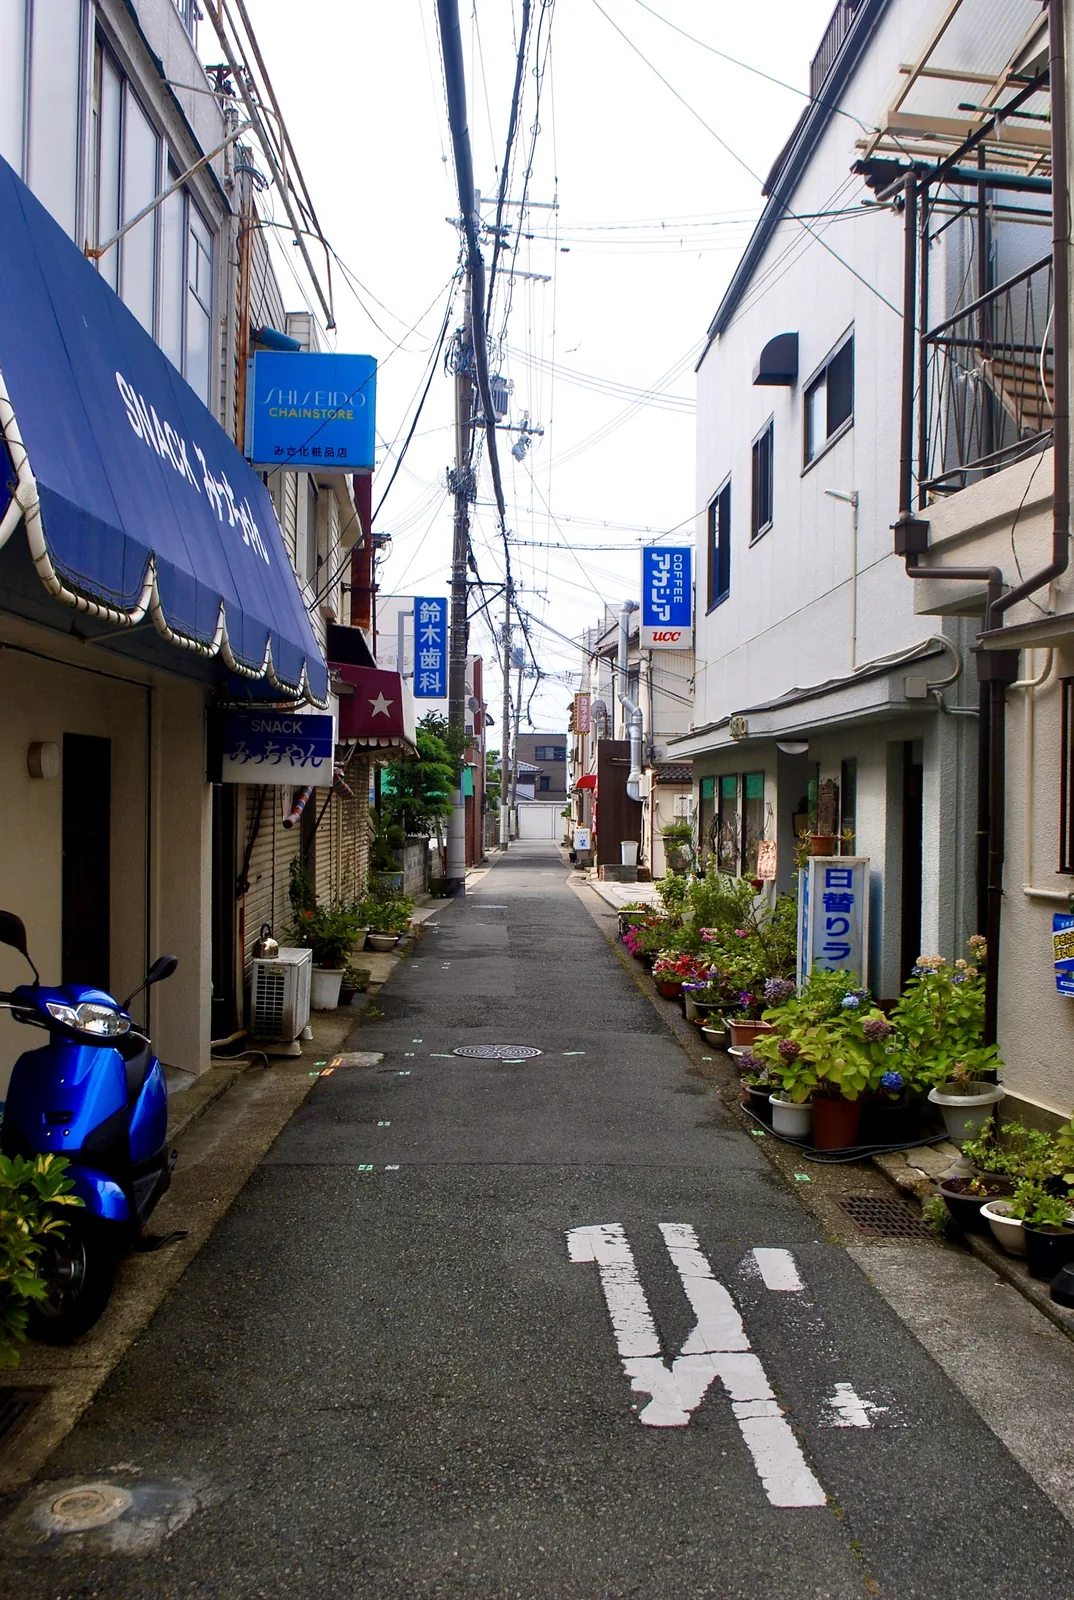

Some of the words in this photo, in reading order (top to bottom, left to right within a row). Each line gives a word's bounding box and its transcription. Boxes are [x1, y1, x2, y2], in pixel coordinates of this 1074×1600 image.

[257, 387, 366, 407] SHISEIDO
[268, 407, 354, 420] CHAINSTORE
[115, 371, 201, 493] SNACK
[273, 445, 348, 458] みさ化粧品店
[673, 554, 683, 603] COFFEE
[419, 601, 442, 693] 鈴木歯科
[250, 719, 303, 734] SNACK
[580, 698, 588, 730] カラオケ
[822, 868, 855, 975] 日替りラ
